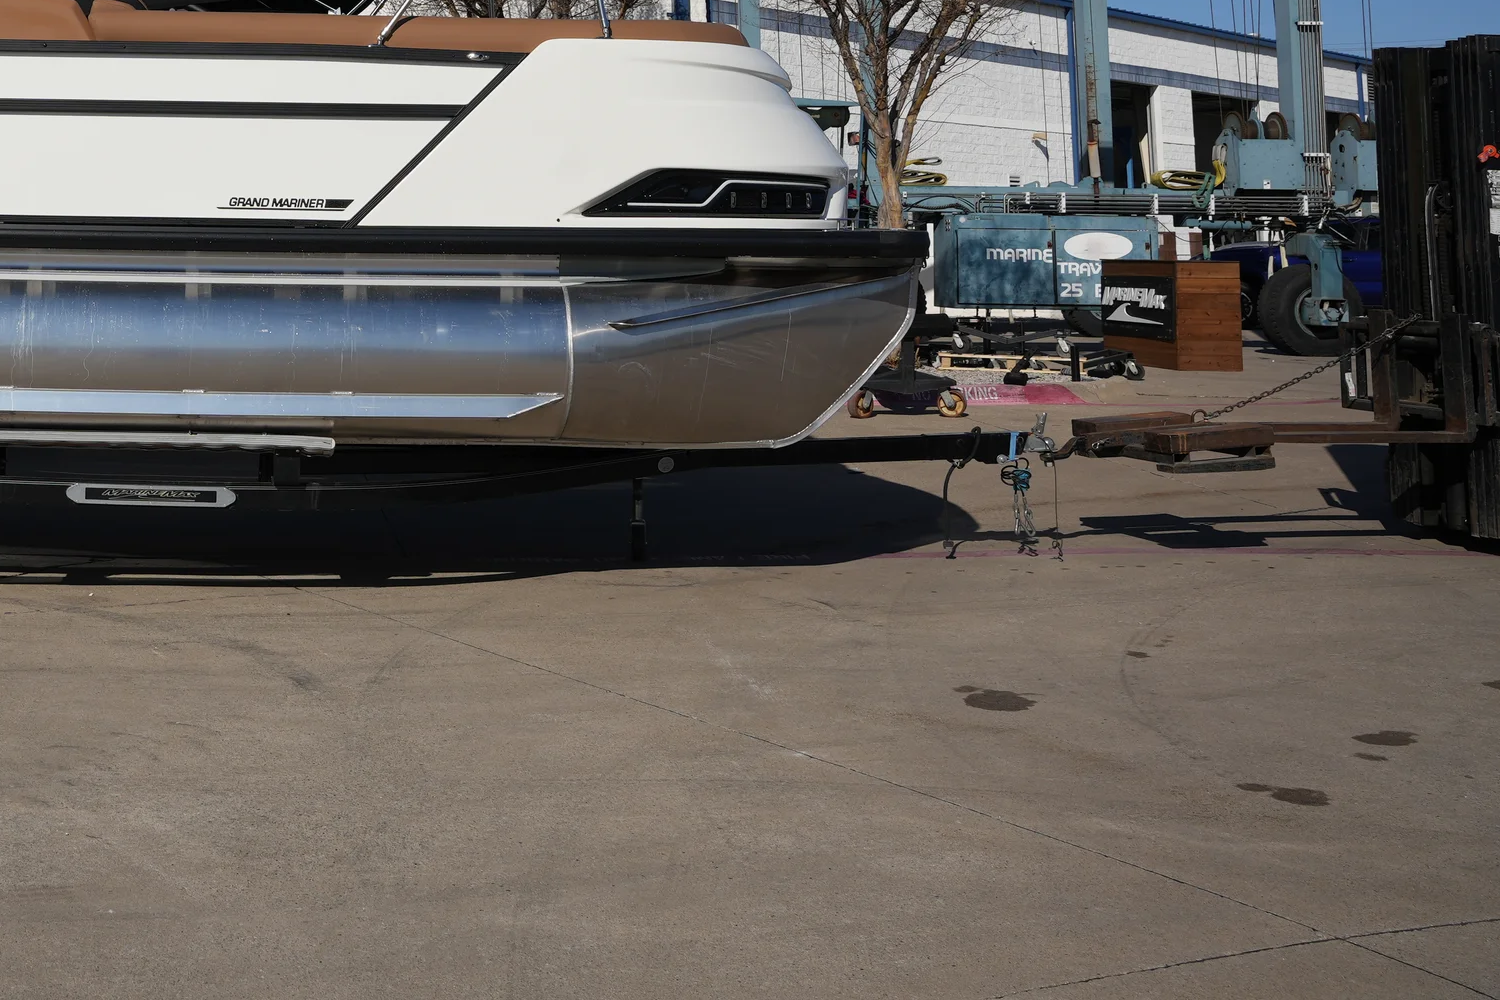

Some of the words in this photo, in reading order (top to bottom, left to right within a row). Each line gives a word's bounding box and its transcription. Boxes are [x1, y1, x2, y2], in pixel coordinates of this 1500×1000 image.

[228, 197, 270, 208] GRAND
[271, 198, 325, 209] MARINER
[986, 248, 1053, 264] MARINE
[1057, 261, 1102, 277] TRAV
[1060, 283, 1084, 298] 25
